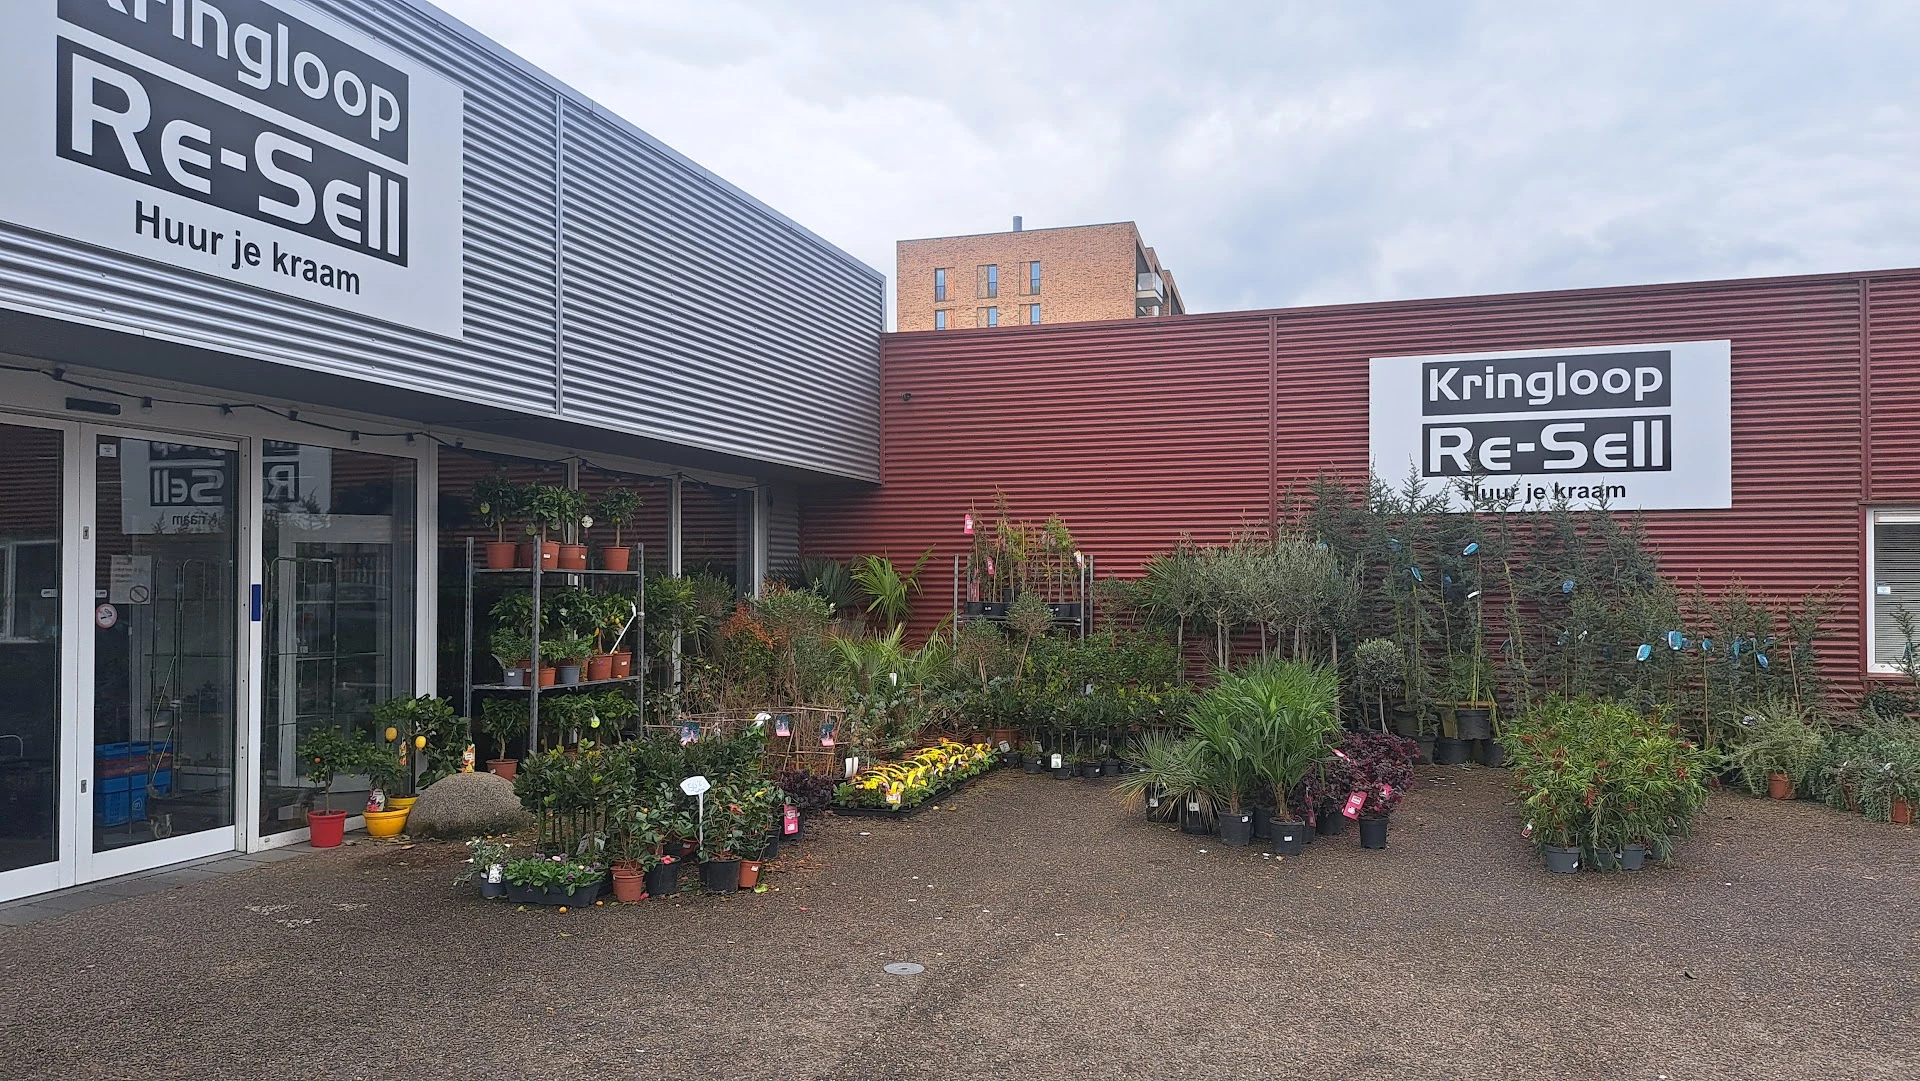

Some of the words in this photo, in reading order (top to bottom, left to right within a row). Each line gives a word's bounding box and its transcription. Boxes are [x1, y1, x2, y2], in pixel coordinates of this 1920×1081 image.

[106, 0, 400, 140] ingloop
[135, 200, 224, 255] Huur
[231, 230, 261, 269] je
[273, 241, 360, 294] kraam
[1429, 362, 1663, 405] Kringloop
[1464, 483, 1520, 500] Huur
[1525, 483, 1546, 504] je
[1554, 482, 1626, 499] kraam
